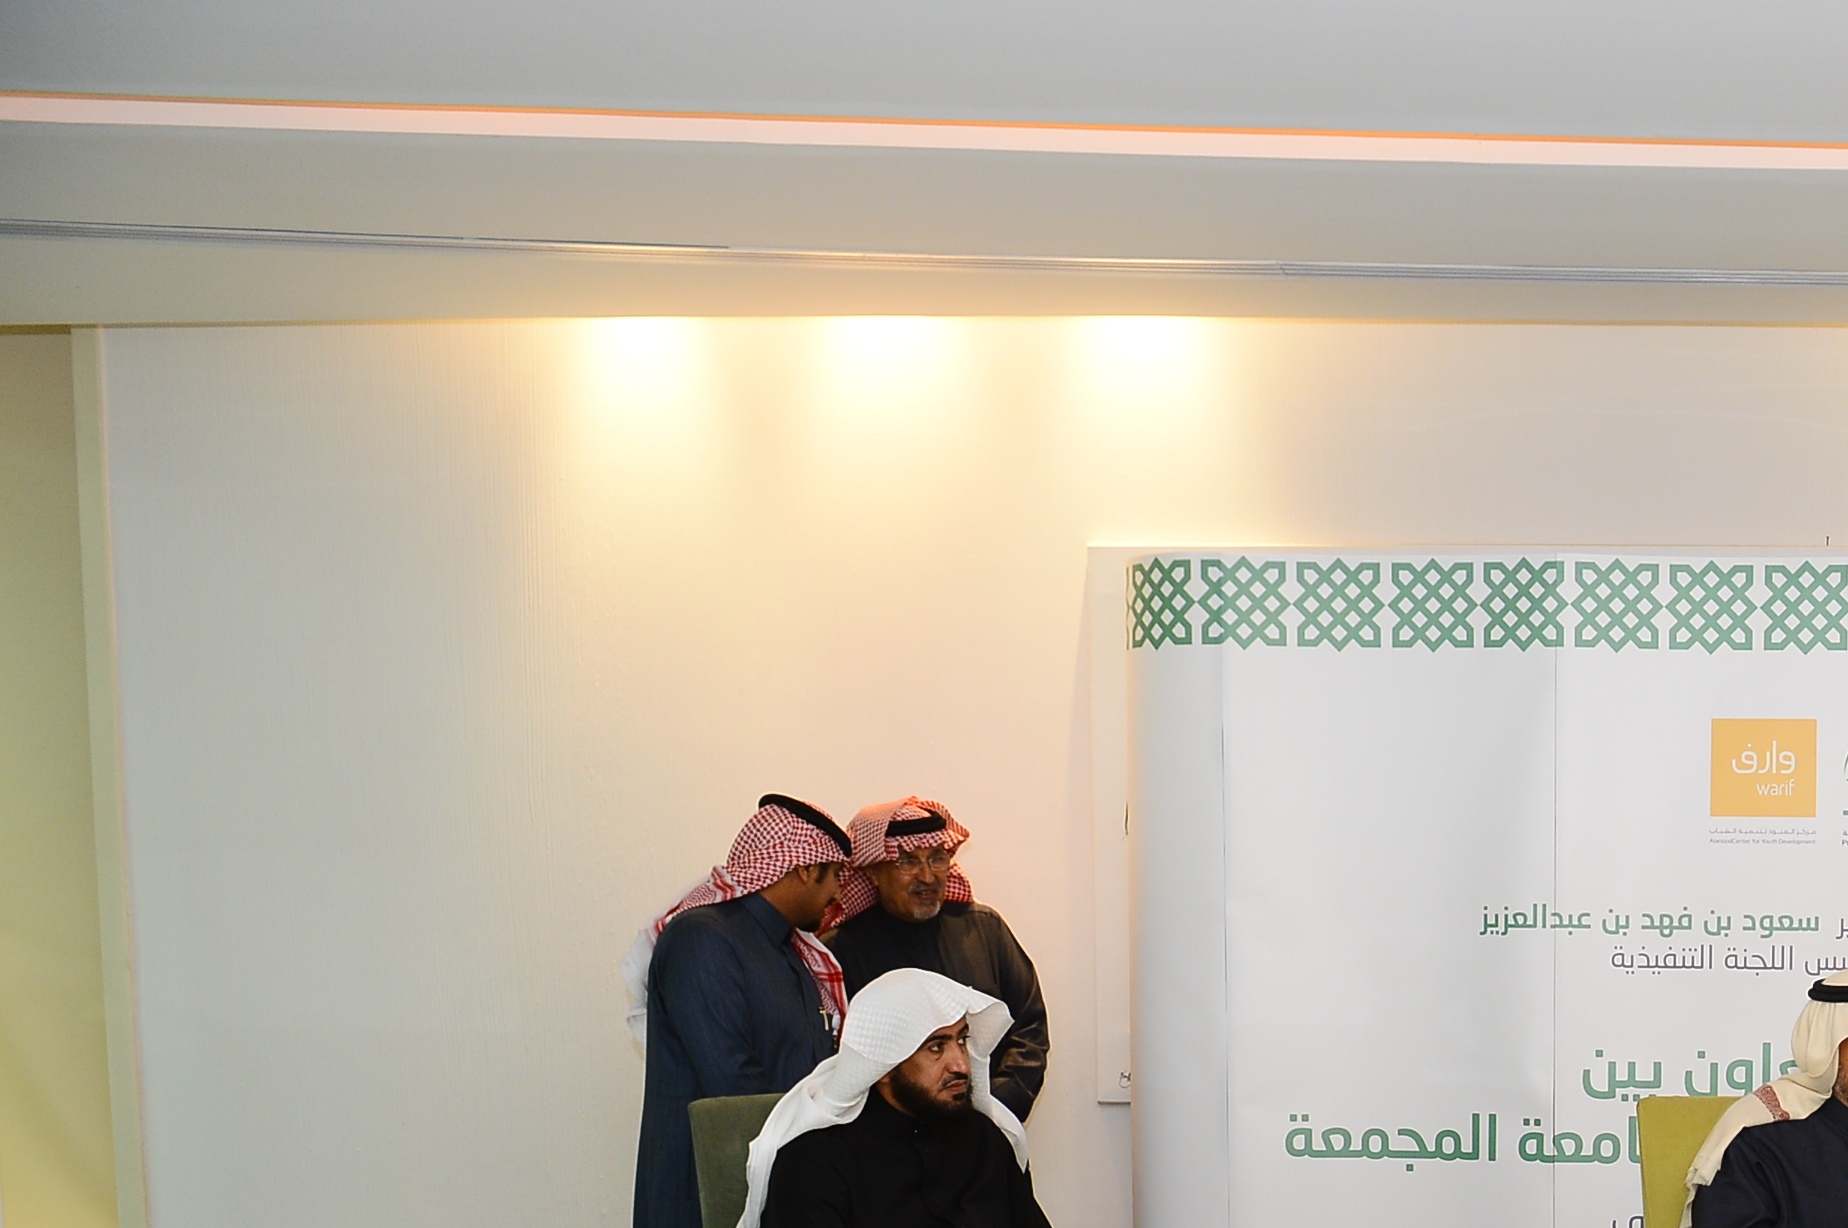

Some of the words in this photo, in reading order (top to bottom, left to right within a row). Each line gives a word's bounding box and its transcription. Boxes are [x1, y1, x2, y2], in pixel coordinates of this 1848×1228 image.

[1731, 740, 1796, 774] وارف
[1756, 779, 1796, 796] warif
[1479, 902, 1593, 937] عبدالعزيز
[1601, 906, 1632, 937] بن
[1640, 905, 1694, 939] فهد
[1702, 908, 1733, 938] بن
[1742, 909, 1821, 940] سعود
[1610, 943, 1713, 976] التنفيذية
[1723, 945, 1794, 977] اللجنة
[1582, 1049, 1663, 1102] بين
[1285, 1112, 1498, 1174] المجمعة
[1518, 1116, 1642, 1165] امعة
